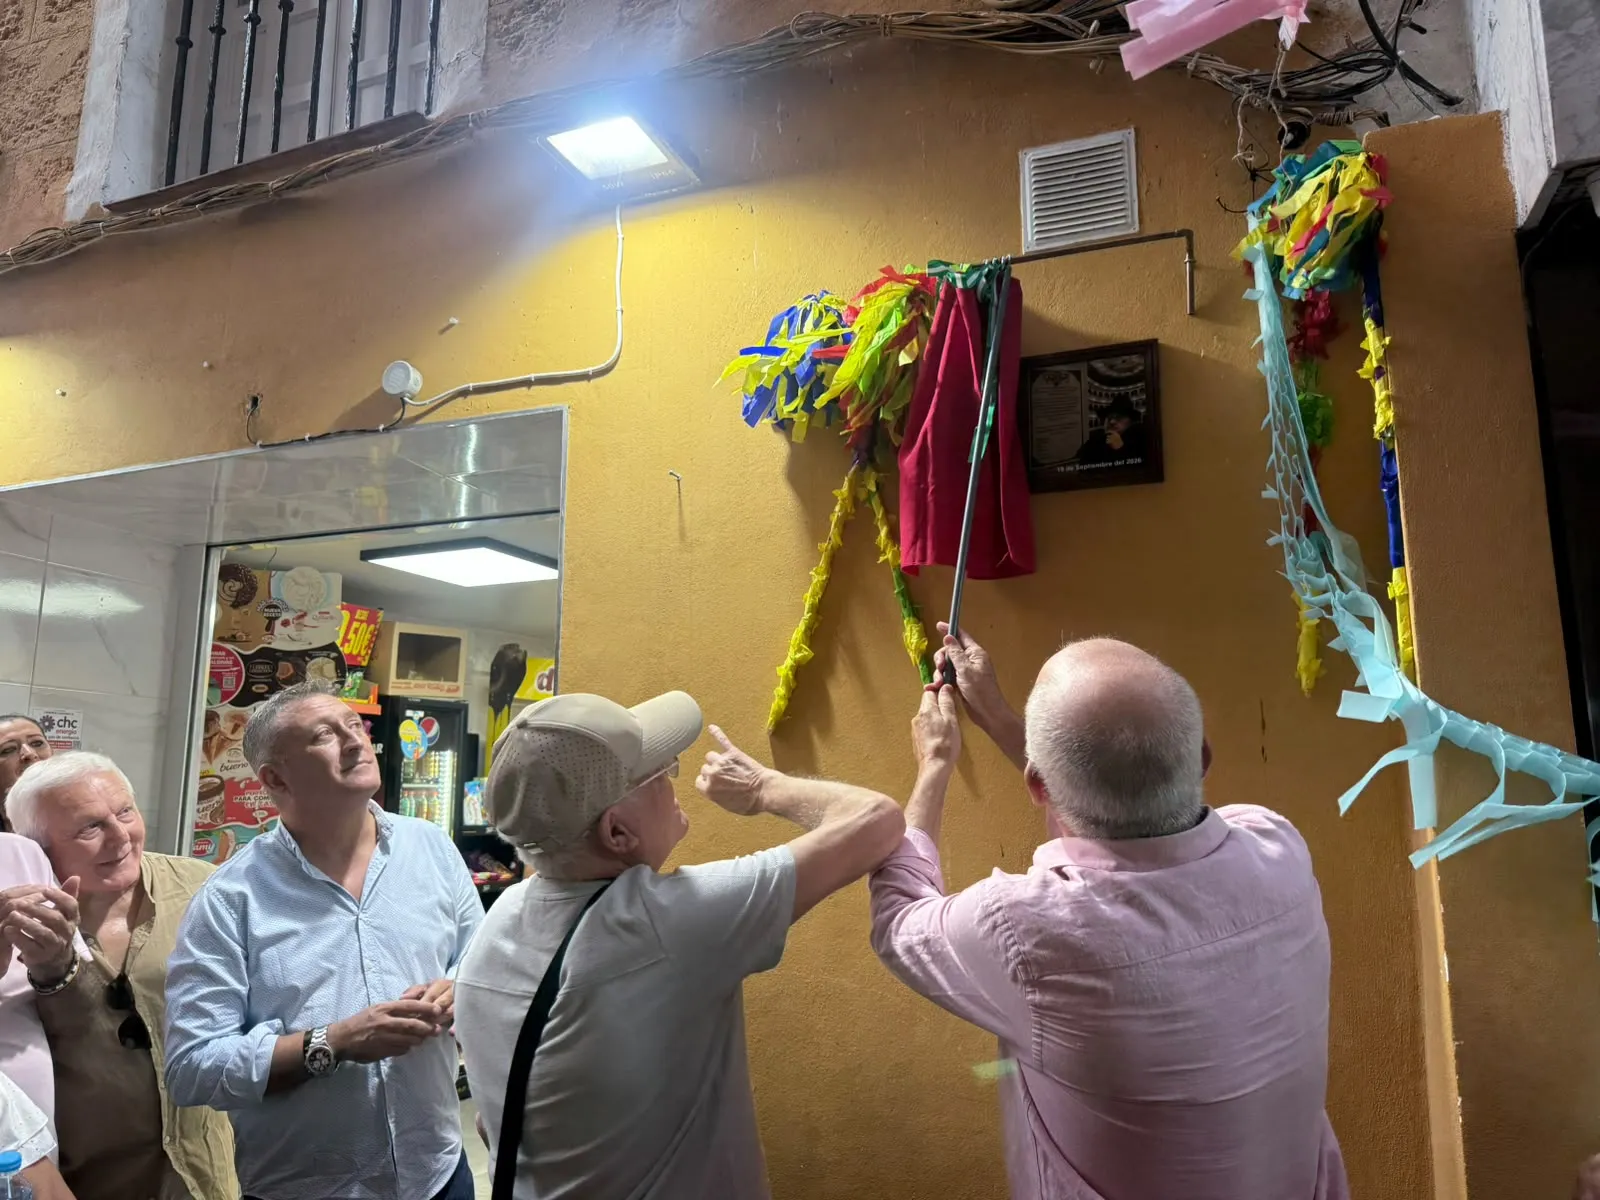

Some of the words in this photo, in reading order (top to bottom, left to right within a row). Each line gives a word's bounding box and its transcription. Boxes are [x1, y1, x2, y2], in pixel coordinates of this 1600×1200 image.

[1075, 460, 1113, 472] Septiembre
[1114, 459, 1125, 467] del
[57, 716, 78, 729] chc
[219, 762, 249, 773] bueno
